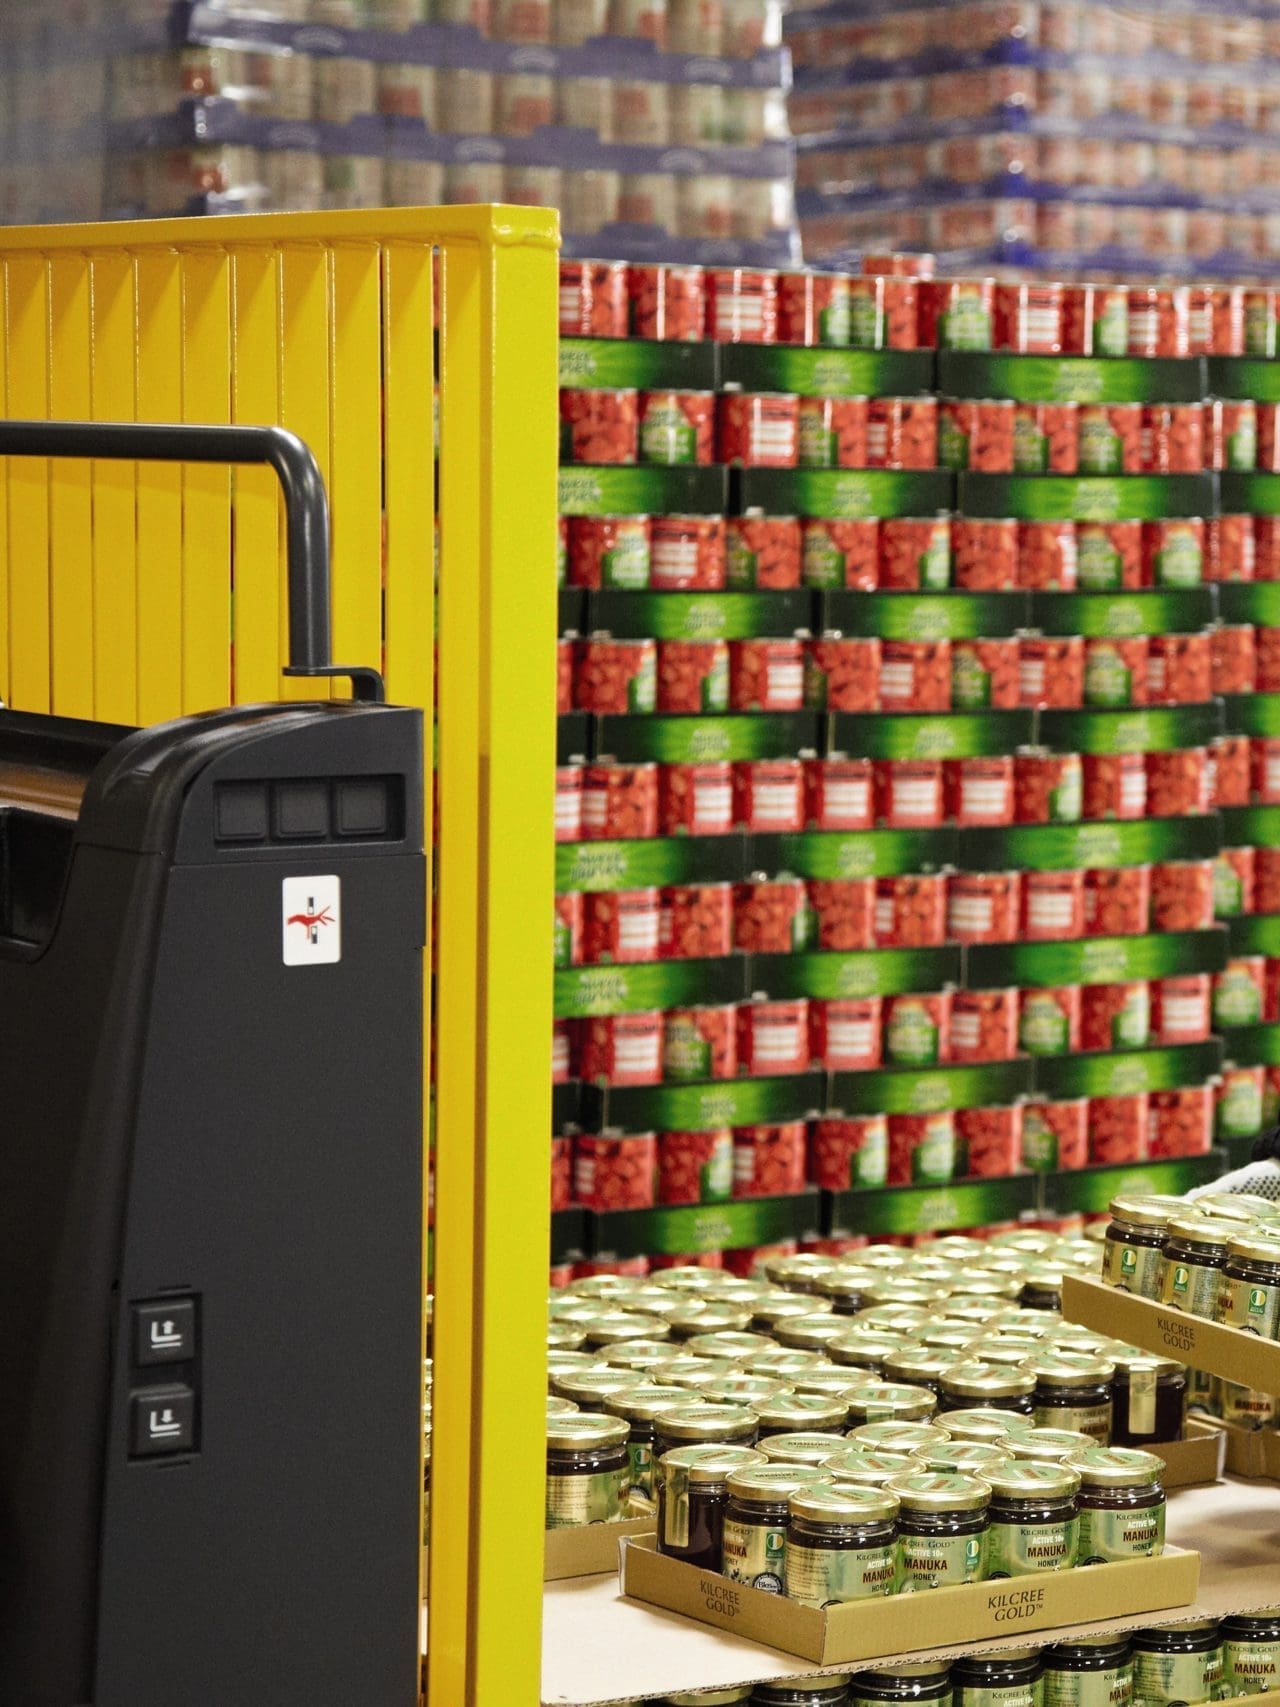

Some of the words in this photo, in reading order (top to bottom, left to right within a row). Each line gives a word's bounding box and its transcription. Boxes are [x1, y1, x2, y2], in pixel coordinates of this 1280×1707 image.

[1157, 1317, 1195, 1340] KILCREE
[1127, 1519, 1147, 1529] ACTIVE
[1032, 1535, 1053, 1545] ACTIVE
[1123, 1527, 1159, 1542] MANUKA
[1027, 1544, 1066, 1558] MANUKA
[1133, 1542, 1151, 1552] HONEY
[904, 1558, 948, 1571] MANUKA
[1037, 1559, 1058, 1567] HONEY
[862, 1567, 895, 1584] MANUKA
[913, 1572, 936, 1581] HONEY
[700, 1579, 740, 1606] KILCREE
[988, 1588, 1045, 1610] KILCREE
[1238, 1653, 1261, 1662] ACTIVE
[1234, 1663, 1276, 1675] MANUKA
[1243, 1677, 1266, 1685] HONEY
